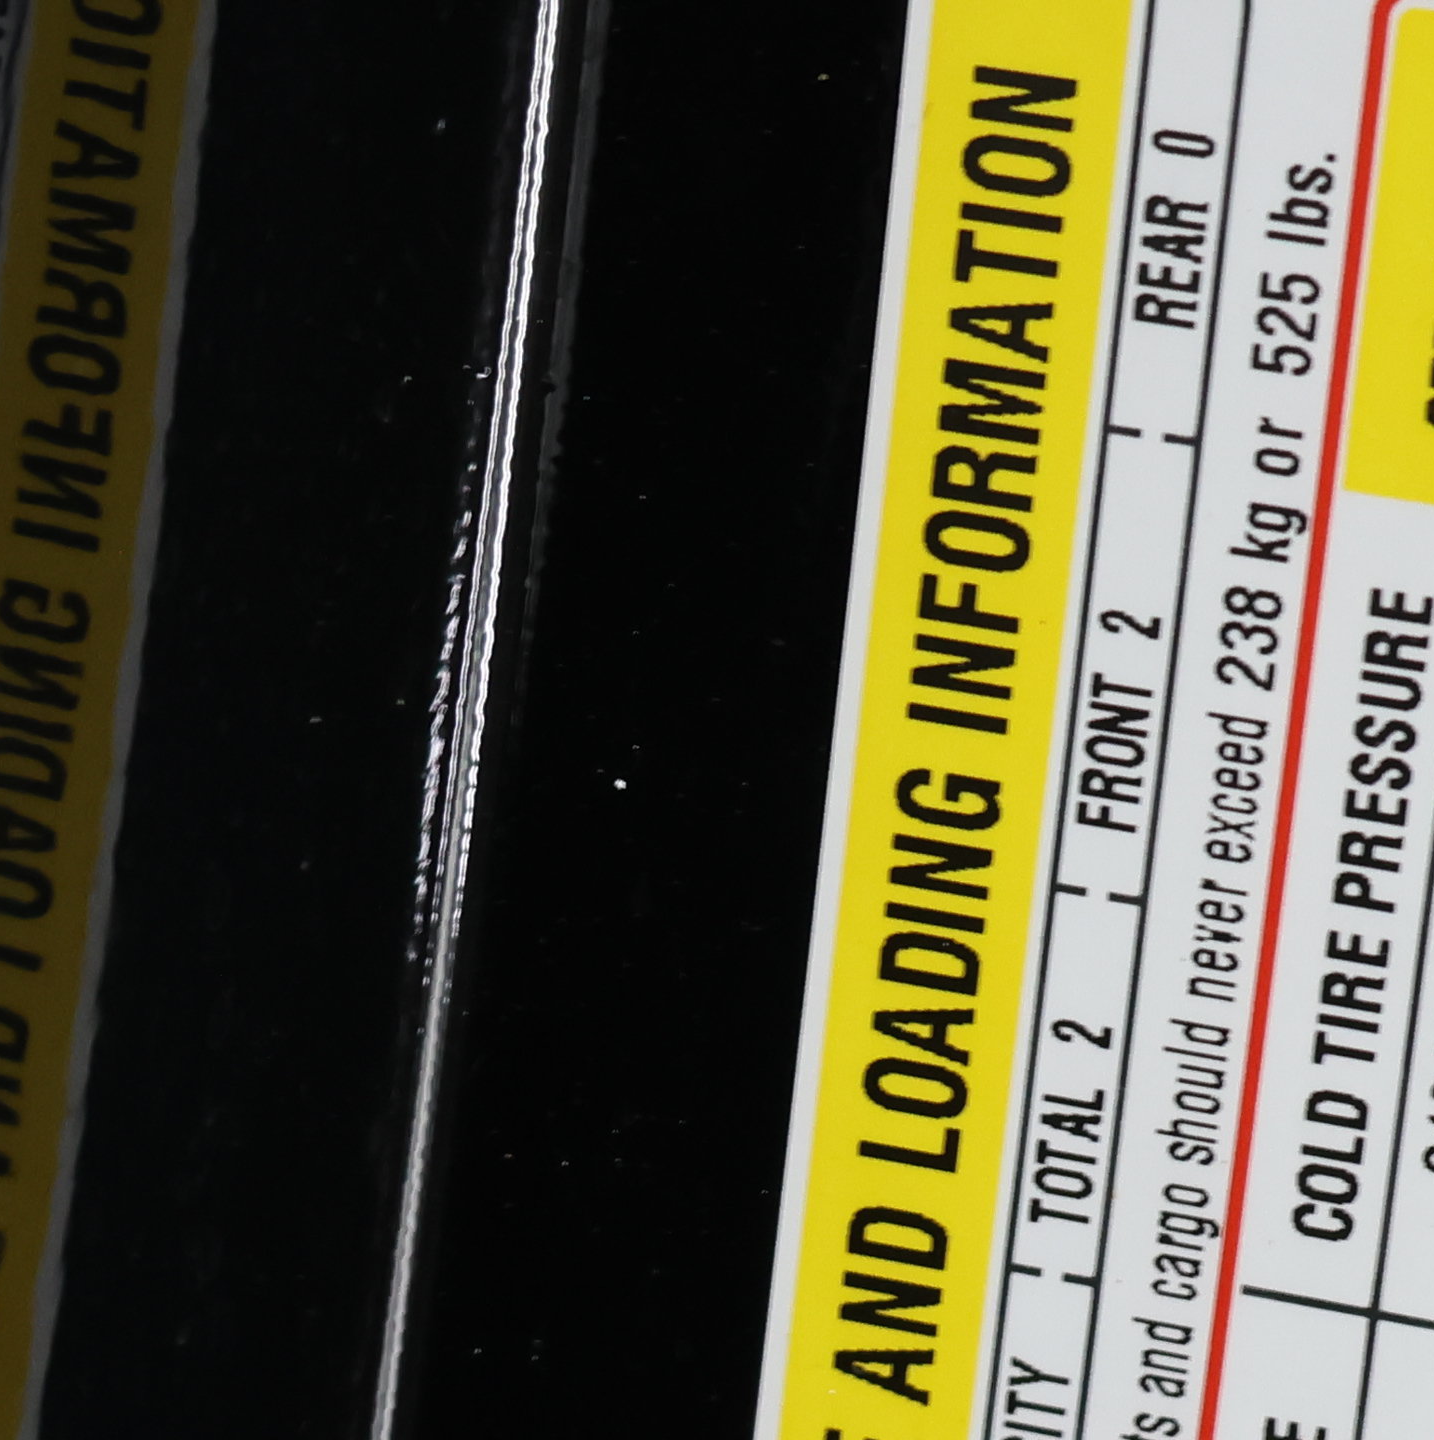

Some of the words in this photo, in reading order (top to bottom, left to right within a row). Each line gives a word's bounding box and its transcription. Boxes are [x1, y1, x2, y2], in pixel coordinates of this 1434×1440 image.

[1150, 128, 1217, 160] 0
[1264, 152, 1337, 248] lbs.
[1131, 193, 1210, 331] REAR
[1249, 271, 1322, 378] 525
[905, 64, 1079, 737] INFORMATION
[1253, 416, 1305, 478] or
[1228, 501, 1307, 565] kg
[1097, 608, 1163, 642] 2
[1213, 584, 1284, 693] 238
[1074, 671, 1154, 835] FRONT
[1203, 710, 1269, 865] exceed
[1331, 587, 1434, 915] PRESSURE
[856, 767, 1003, 1175] LOADING
[1186, 877, 1248, 1004] never
[1311, 929, 1391, 1066] TIRE
[1049, 1018, 1114, 1051] 2
[1155, 1017, 1232, 1167] should
[1027, 1087, 1106, 1226] TOTAL
[1291, 1089, 1370, 1243] COLD
[831, 1204, 950, 1408] AND
[1150, 1182, 1221, 1302] cargo
[1131, 1316, 1194, 1400] and
